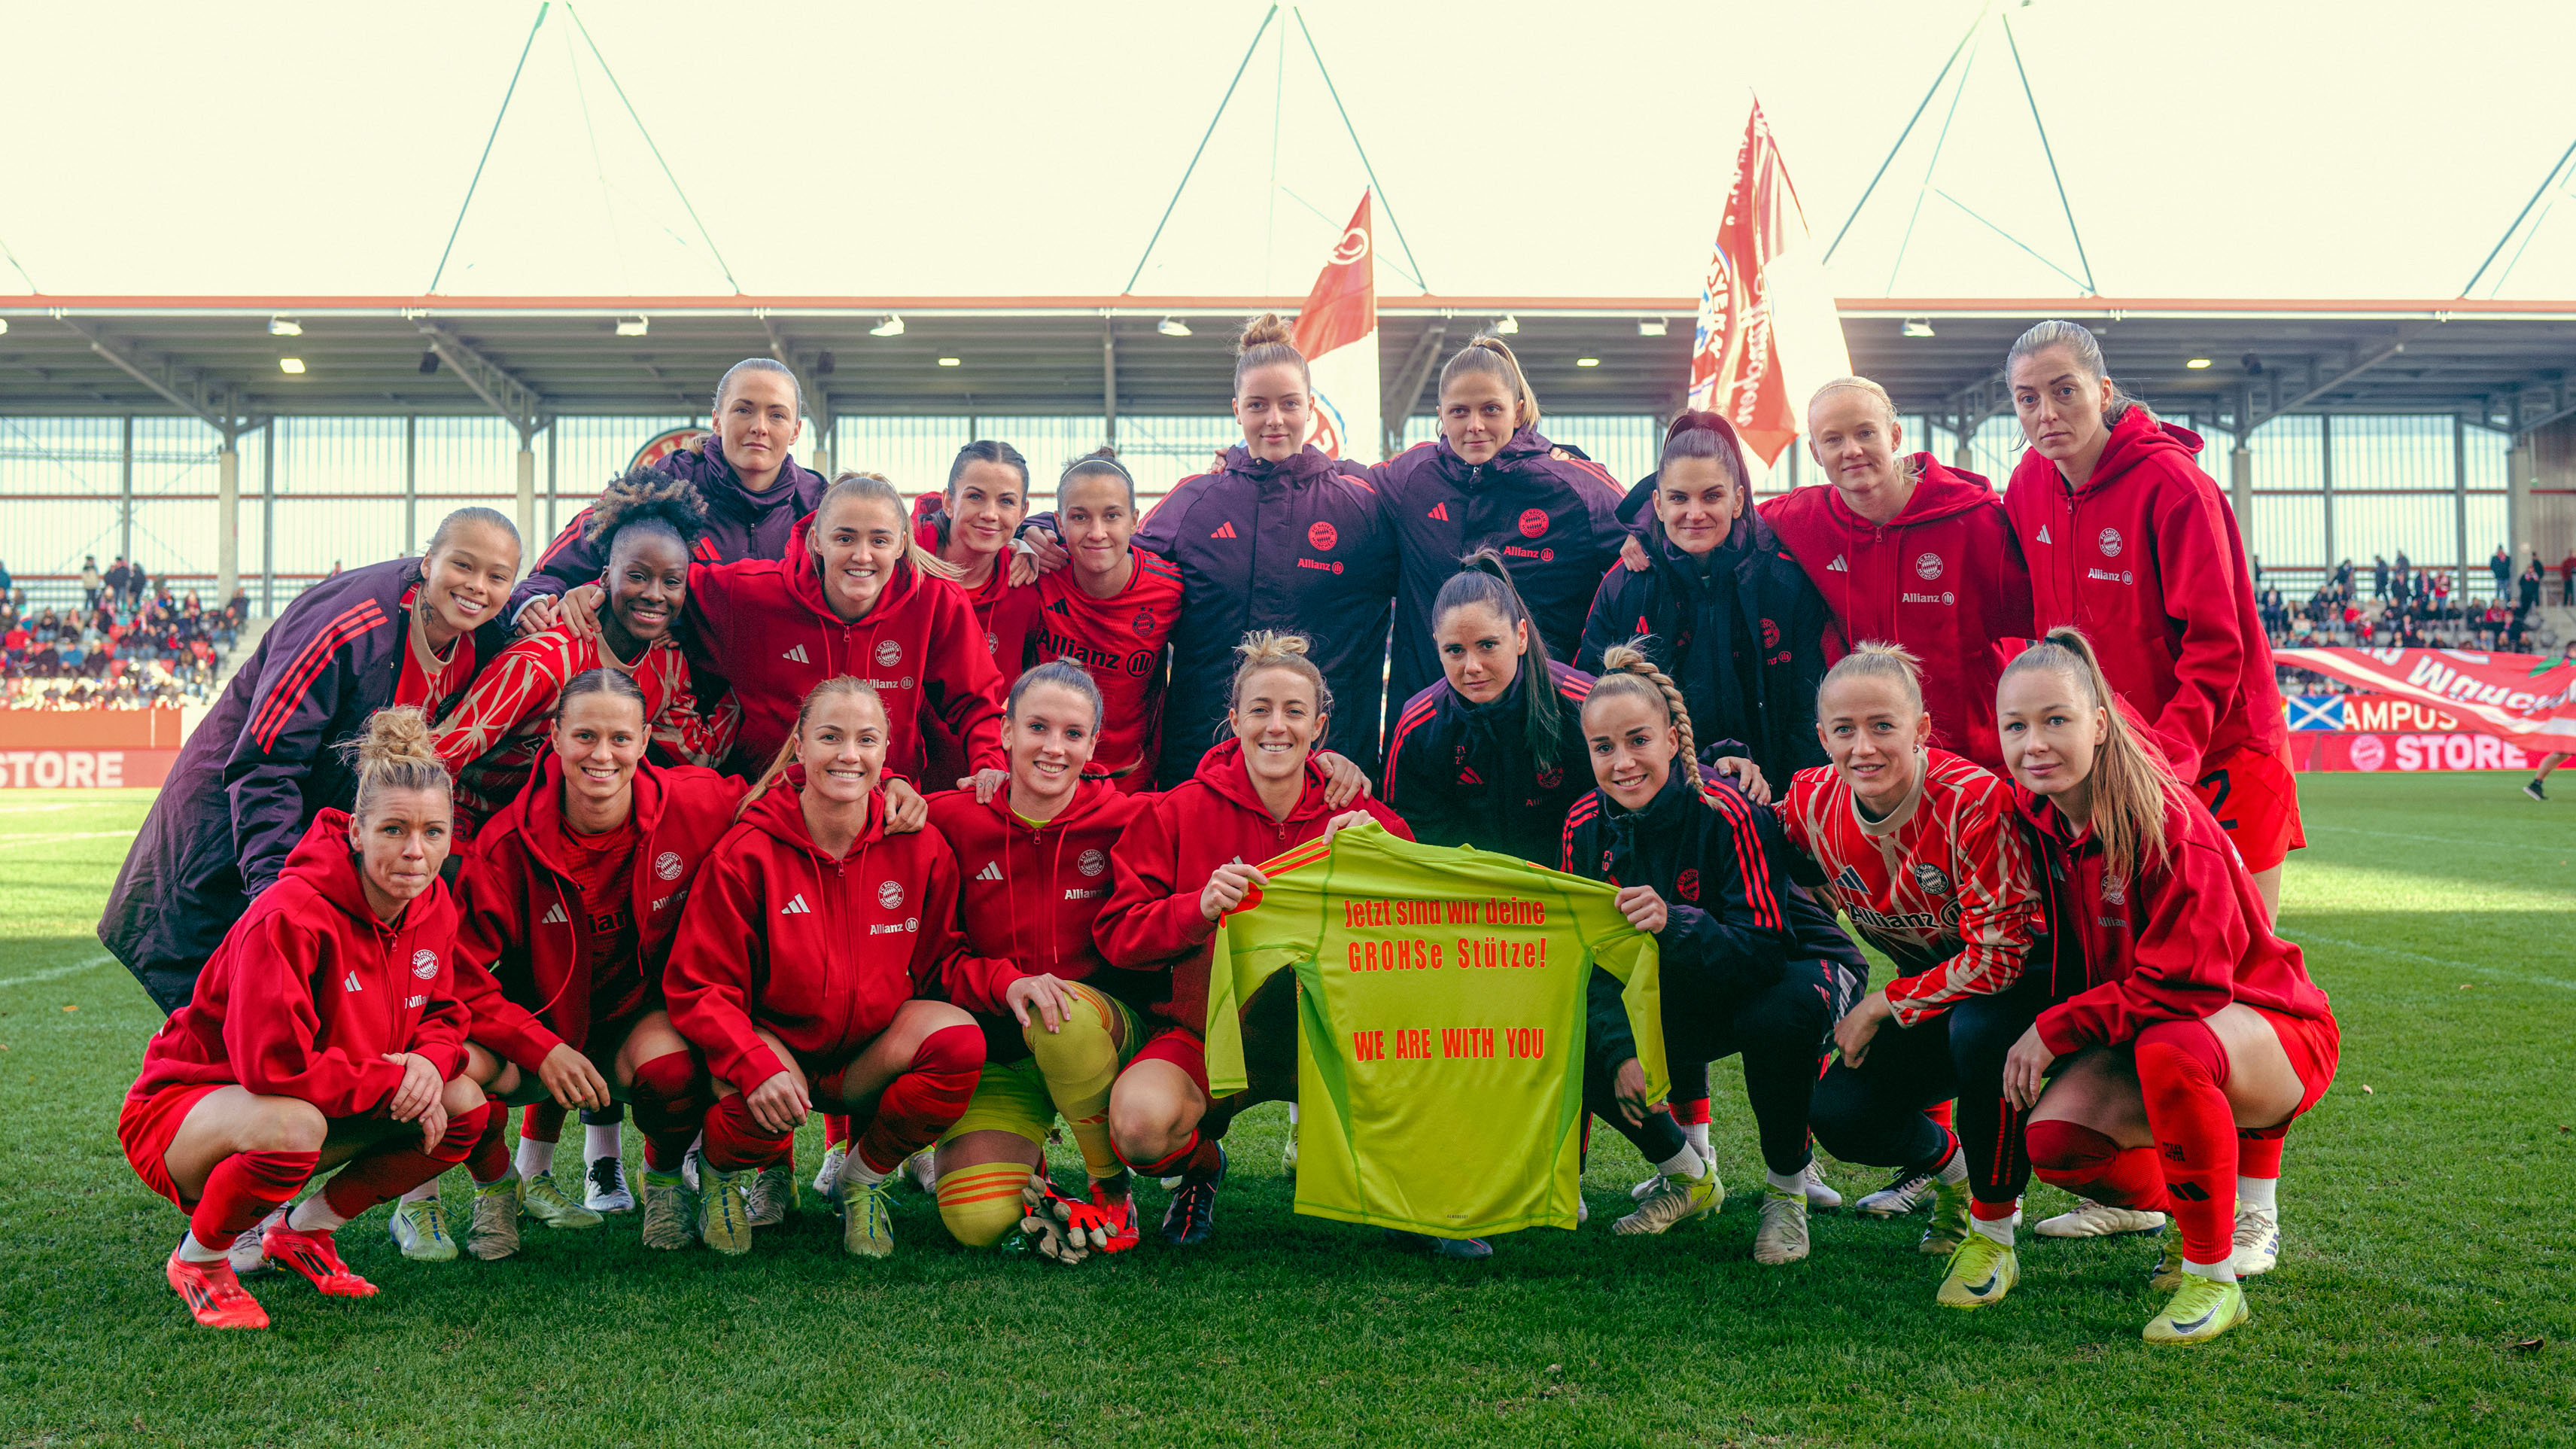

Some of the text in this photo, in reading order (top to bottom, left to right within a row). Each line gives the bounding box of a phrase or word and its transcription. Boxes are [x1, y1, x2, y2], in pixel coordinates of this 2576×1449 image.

[1528, 511, 1546, 522] BAYERN
[1318, 524, 1334, 535] BAYERN
[2105, 529, 2121, 541] BAYERN
[1504, 546, 1539, 559] Allianz
[1297, 558, 1331, 571] Allianz
[1924, 555, 1941, 565] BAYERN
[2088, 568, 2120, 582] Allianz
[1902, 592, 1940, 603] Allianz
[883, 641, 900, 653] BAYERN
[1036, 627, 1121, 669] Allianz
[862, 678, 899, 689] llianz
[2343, 701, 2459, 731] AMPUS
[2395, 734, 2528, 771] STORE
[1085, 851, 1102, 860] BAYERN
[1916, 863, 1943, 878] FC BAYERN
[884, 882, 902, 893] BAYERN
[1344, 896, 1547, 928] Jetzt sind wir deine
[1845, 902, 1942, 929] Allianz
[870, 924, 904, 936] Allianz
[416, 951, 436, 961] BAYERN
[1348, 936, 1547, 973] GROHSe Stütze!
[1353, 1027, 1545, 1062] WE ARE WITH YOU
